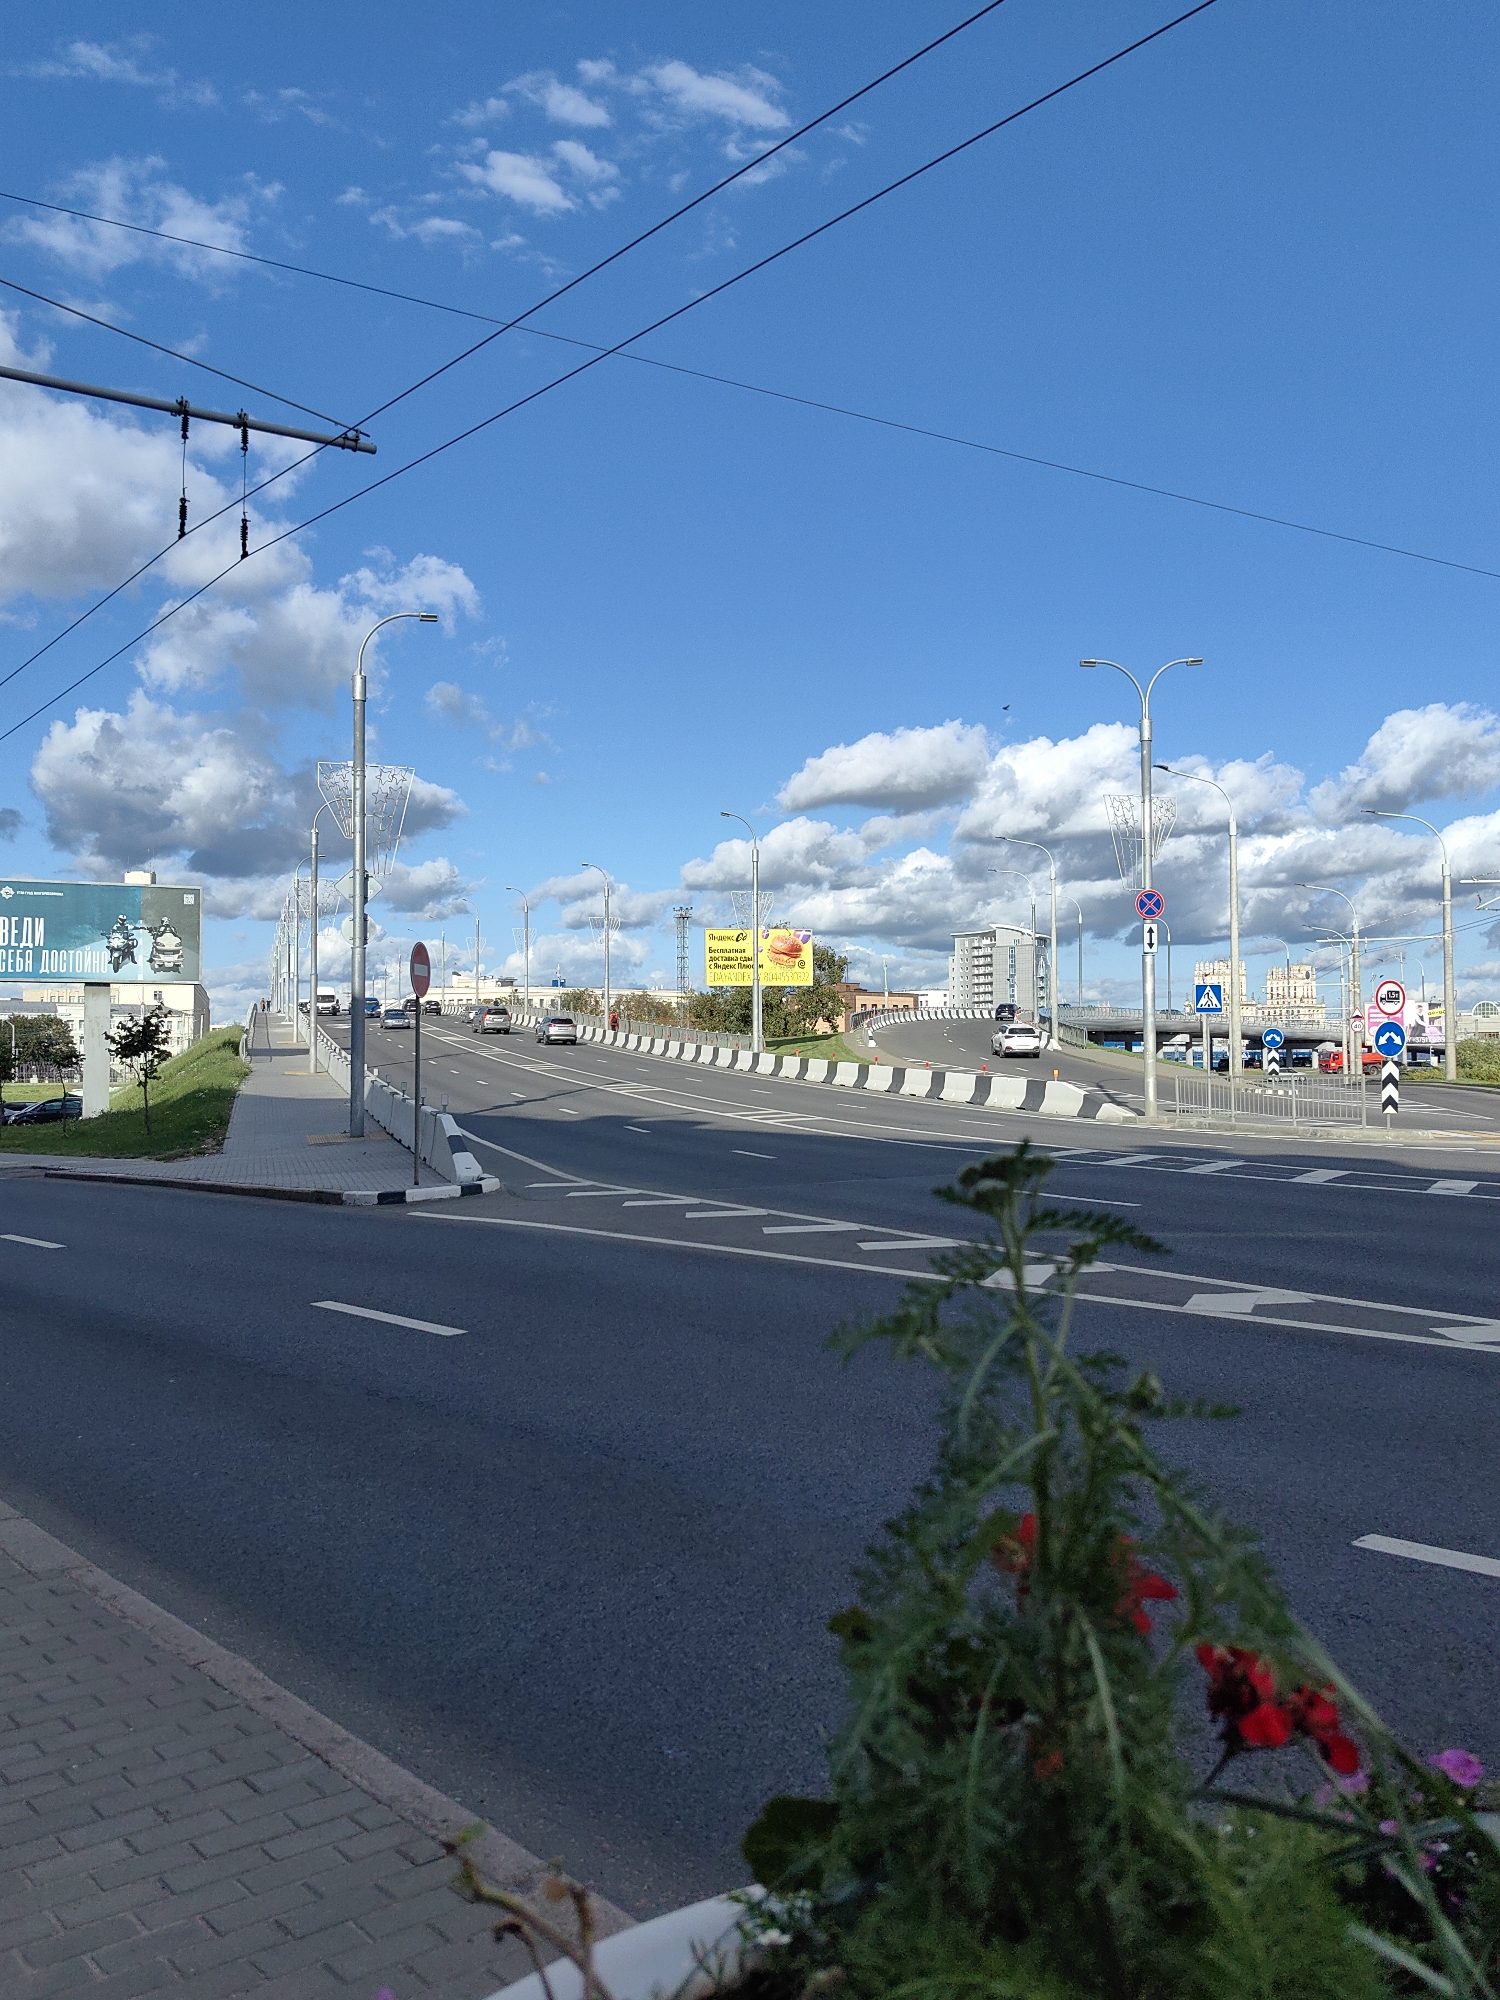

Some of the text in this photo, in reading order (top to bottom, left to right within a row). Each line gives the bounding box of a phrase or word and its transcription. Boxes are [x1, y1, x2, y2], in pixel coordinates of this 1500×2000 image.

[0, 916, 45, 948] ВЕДИ
[708, 933, 735, 943] Яндекс
[708, 946, 746, 954] Бесплатная
[0, 945, 108, 974] СЕБЯ ДОСТОЙНО
[713, 962, 737, 971] Яндекс
